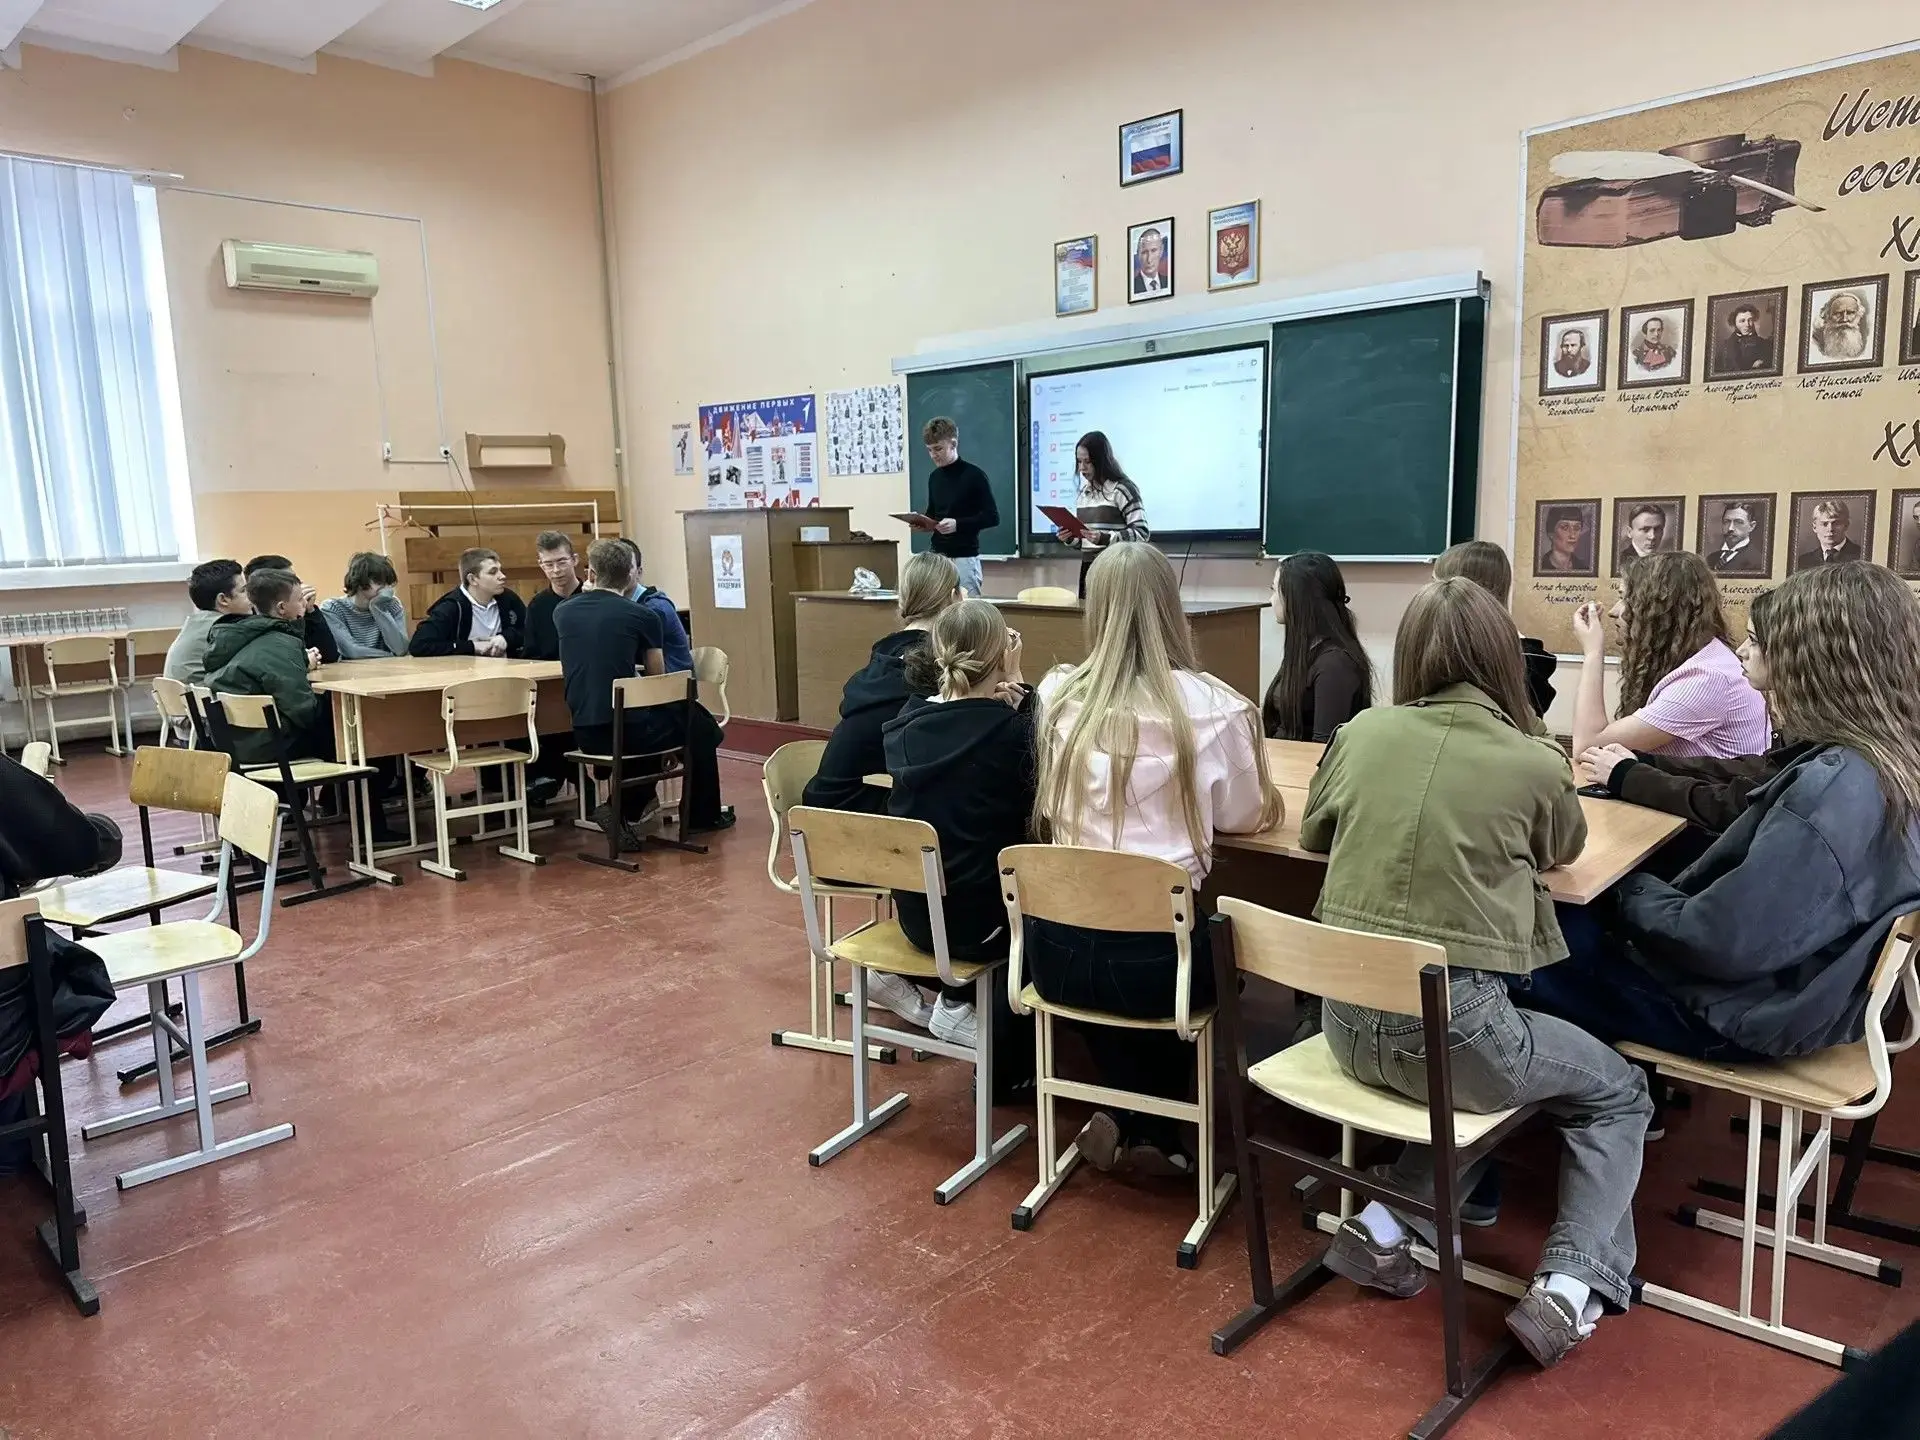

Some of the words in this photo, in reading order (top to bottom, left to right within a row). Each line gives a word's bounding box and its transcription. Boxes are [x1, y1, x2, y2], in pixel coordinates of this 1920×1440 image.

[1796, 376, 1819, 389] Лев
[1819, 371, 1882, 388] Николаевич
[1616, 391, 1652, 404] Михаил
[1725, 392, 1758, 404] Пушкин
[1815, 388, 1864, 401] Толстой
[713, 402, 757, 415] ДВИЖЕНИЕ
[760, 398, 795, 409] ПЕРВЫХ
[1627, 400, 1680, 416] Лермонтов
[1722, 598, 1746, 609] унин
[1544, 1295, 1573, 1327] Reebok
